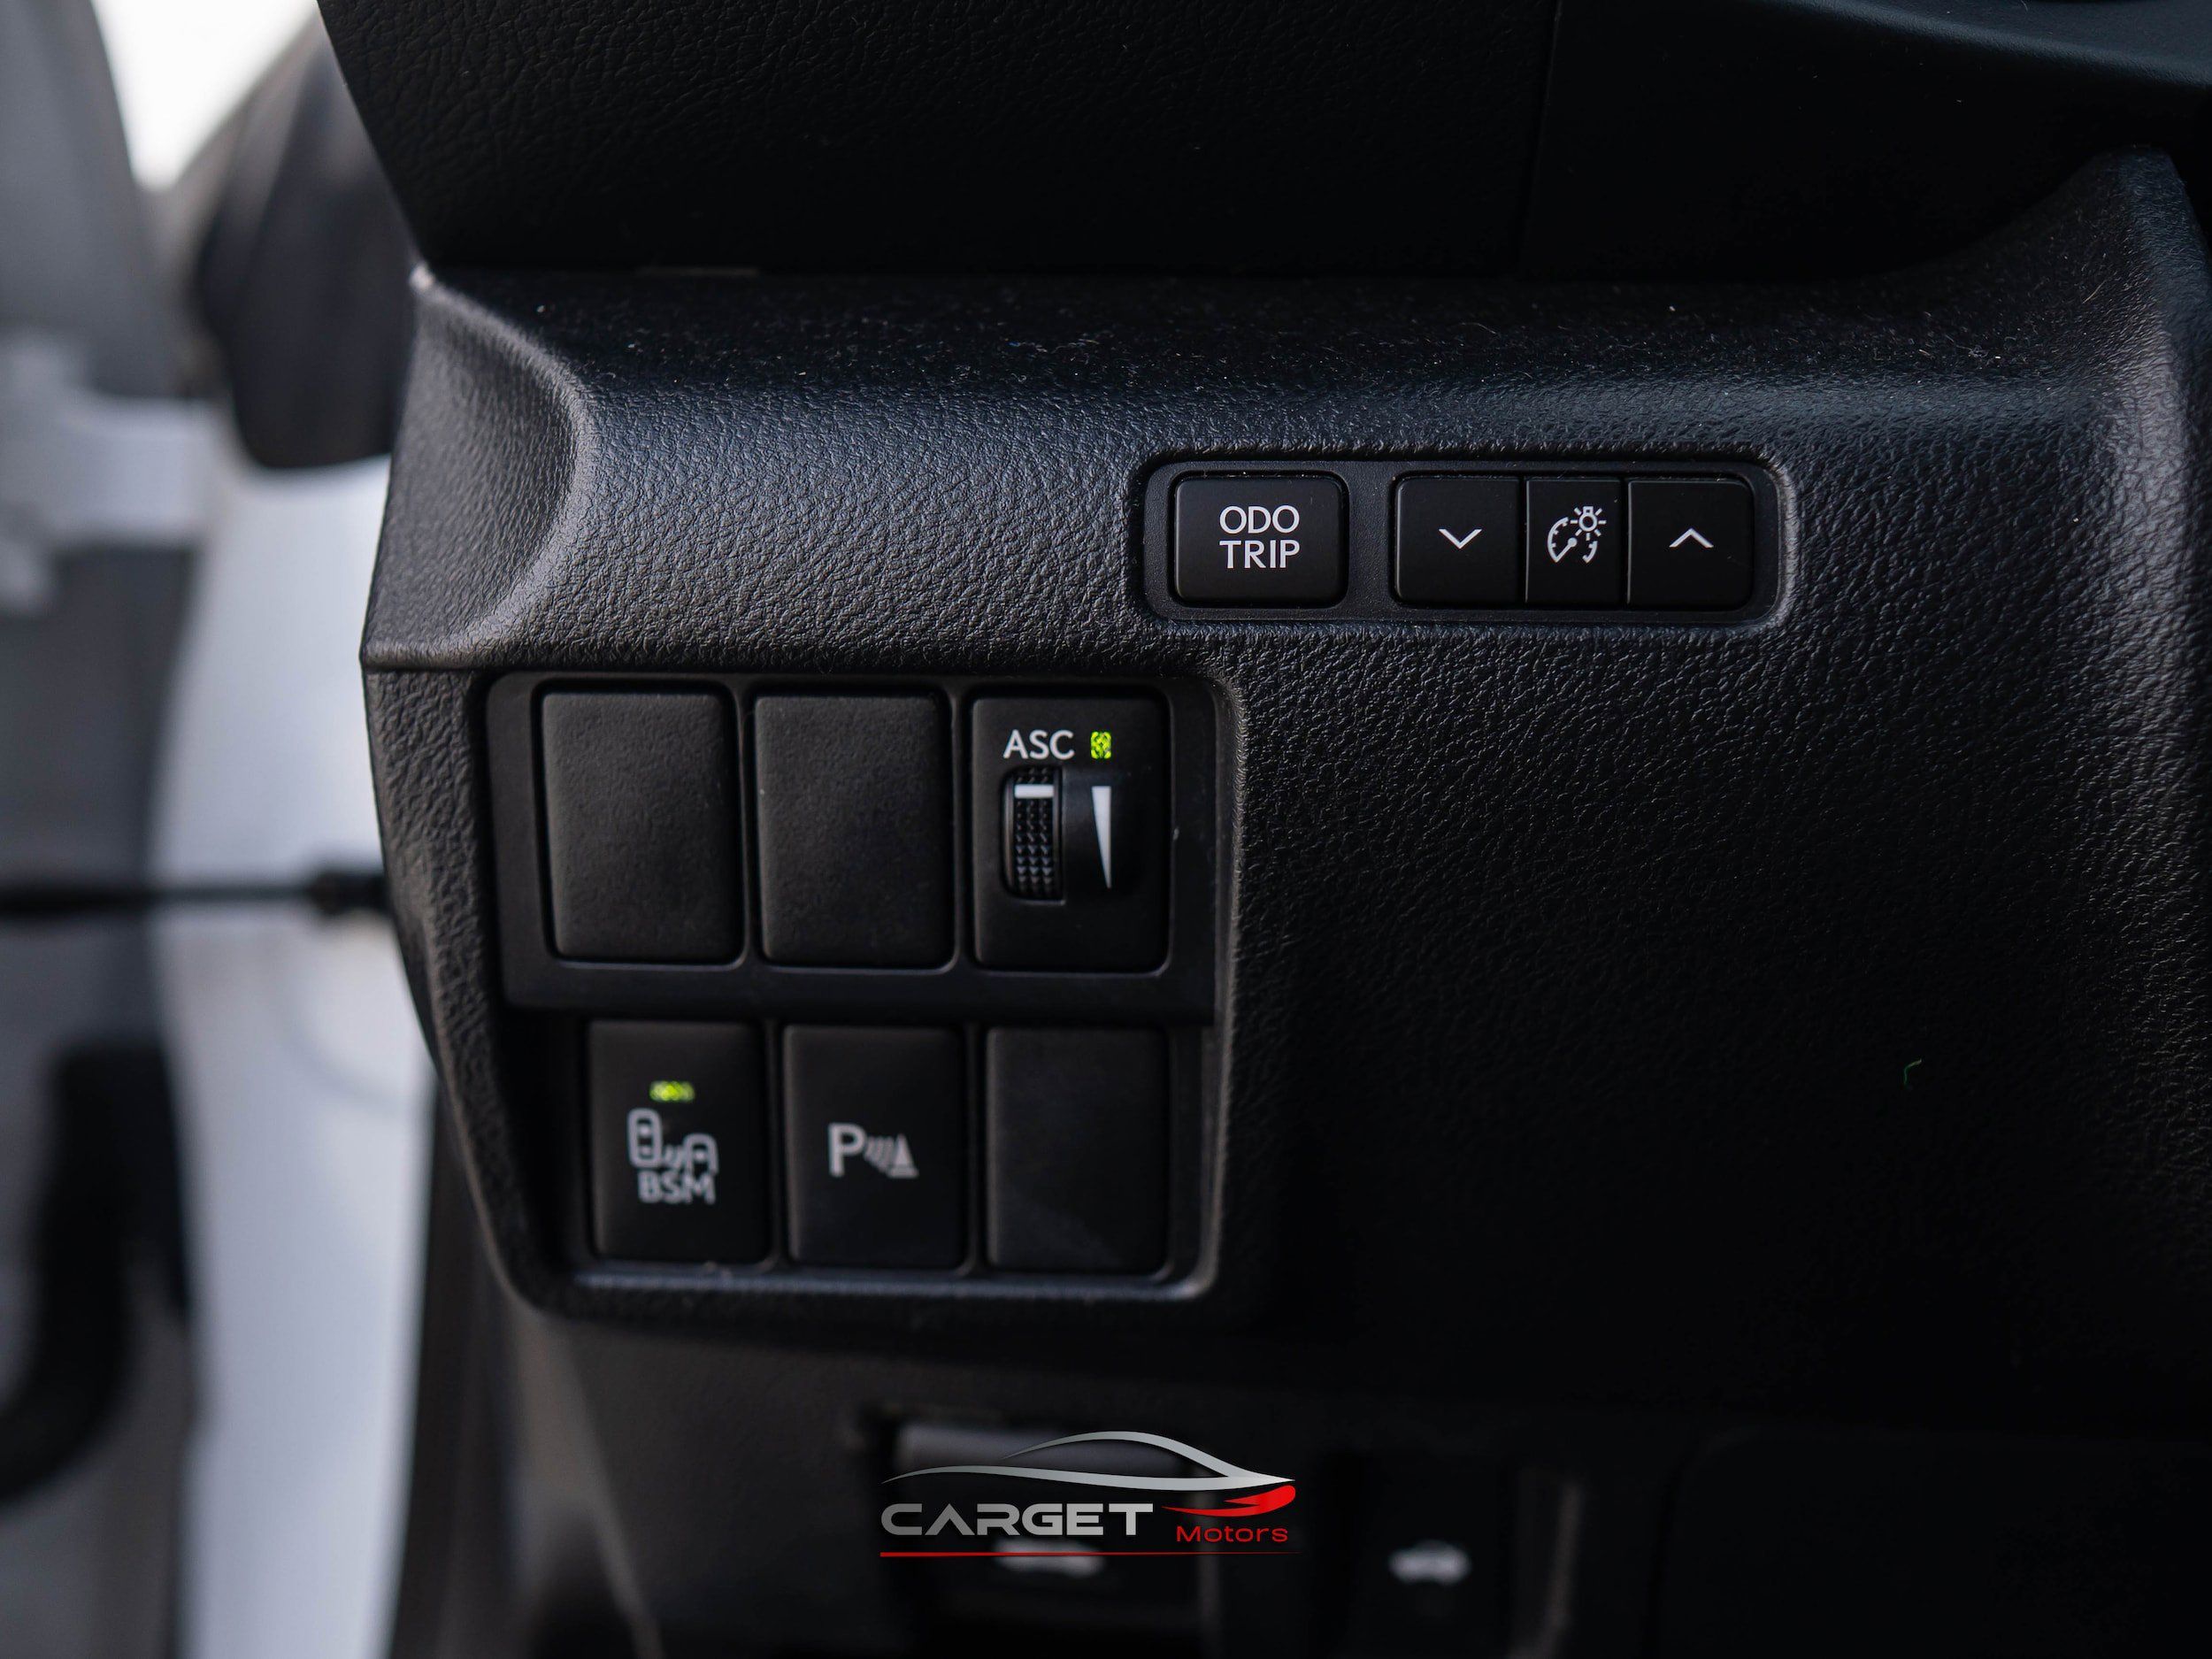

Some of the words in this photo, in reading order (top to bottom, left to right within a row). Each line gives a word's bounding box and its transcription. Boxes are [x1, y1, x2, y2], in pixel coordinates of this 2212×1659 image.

[1219, 504, 1300, 534] ODO
[1218, 539, 1301, 569] TRIP
[1002, 729, 1075, 760] ASC
[828, 1123, 866, 1178] P
[637, 1170, 716, 1204] BSM
